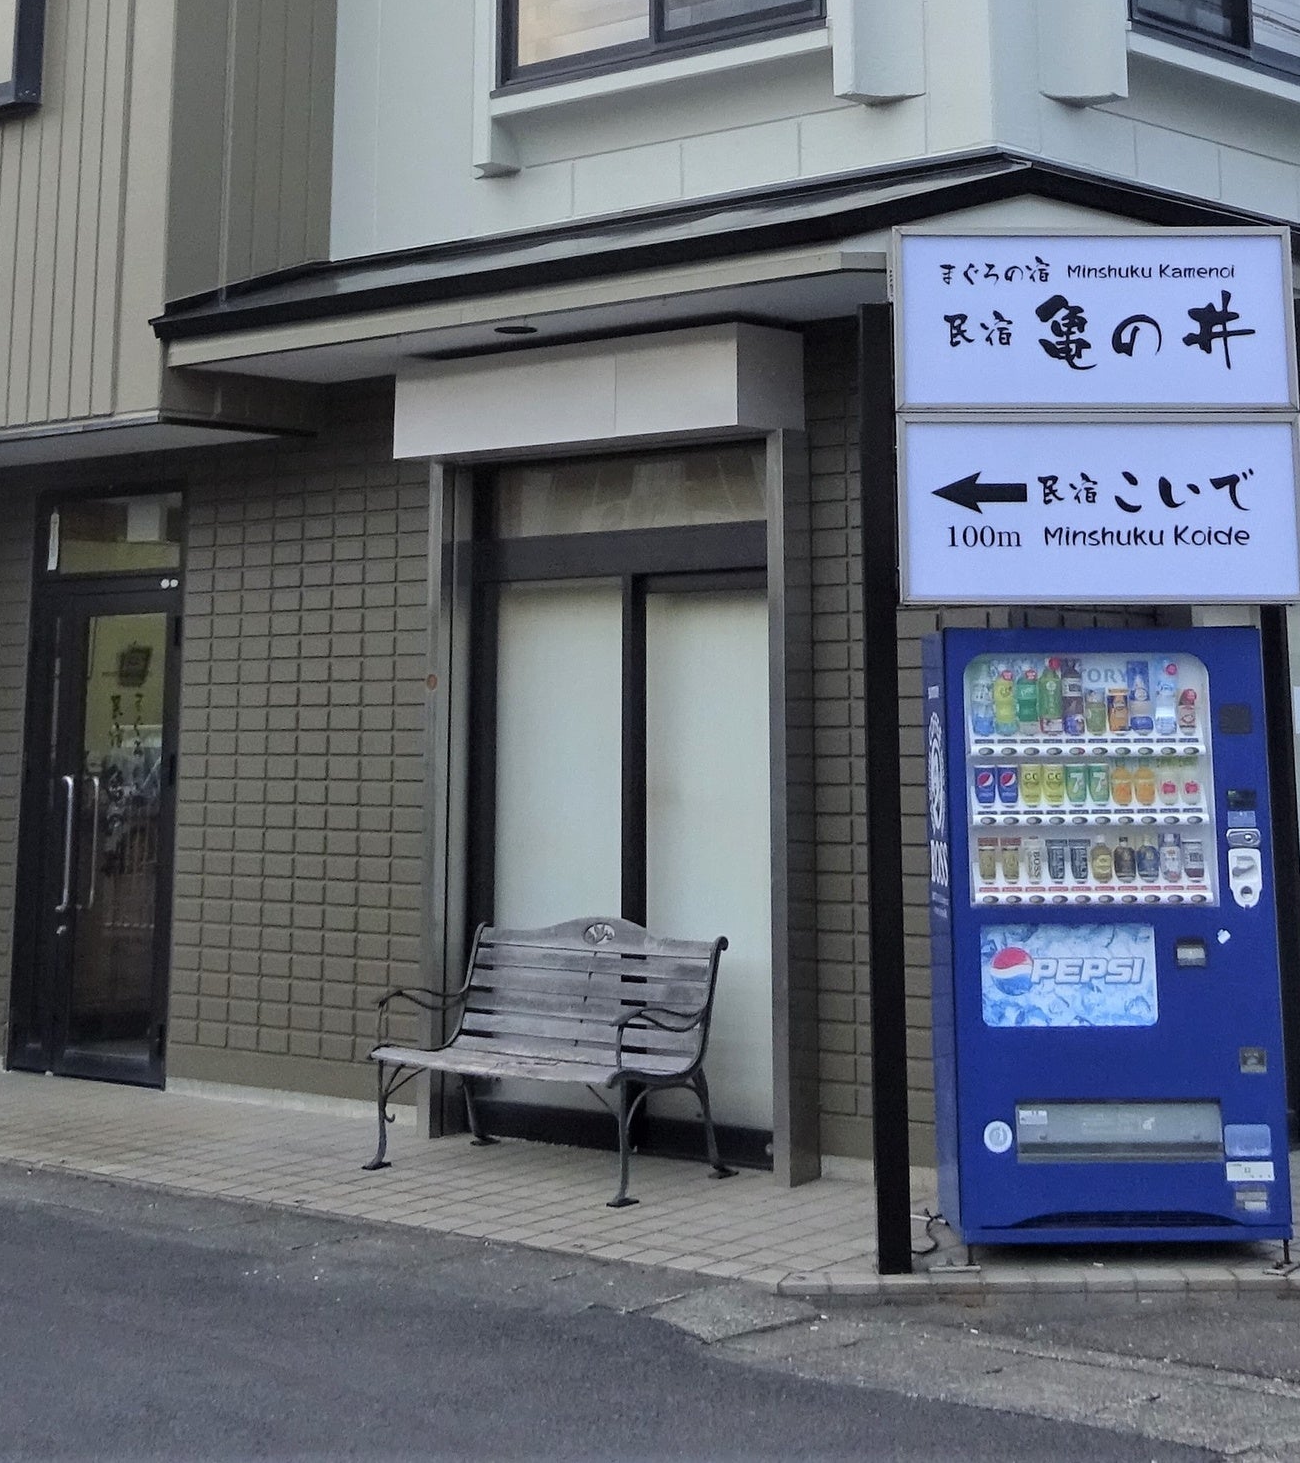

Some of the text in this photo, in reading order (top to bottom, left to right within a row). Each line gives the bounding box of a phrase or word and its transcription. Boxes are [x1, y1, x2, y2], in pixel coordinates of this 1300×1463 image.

[939, 255, 1235, 286] まぐろの宿 Minshuku Kamenoi
[943, 290, 1256, 370] 民宿 亀の井
[1037, 468, 1255, 514] 民宿 こいで
[947, 524, 1251, 548] 100m Minshuku Koide
[1031, 956, 1145, 985] PEPSI
